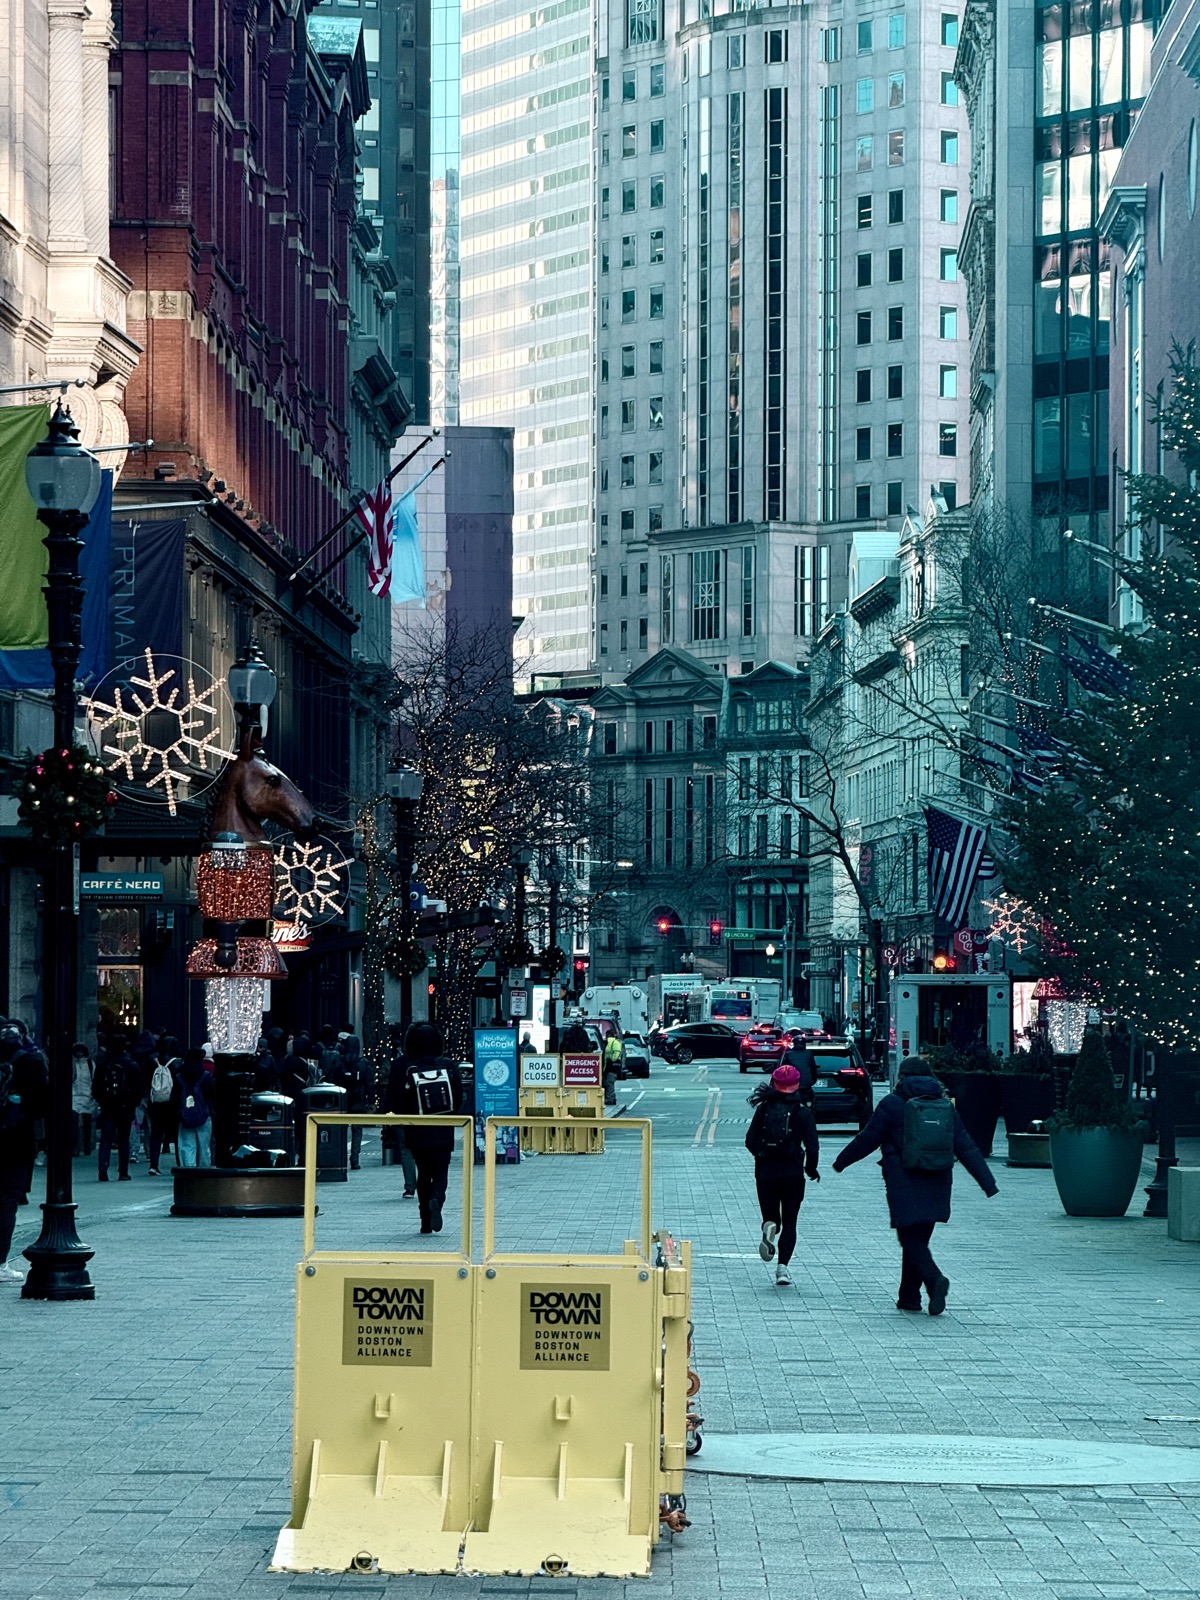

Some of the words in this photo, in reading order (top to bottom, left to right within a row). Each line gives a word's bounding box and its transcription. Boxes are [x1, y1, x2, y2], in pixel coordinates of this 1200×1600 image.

[113, 544, 136, 696] PRIMARK
[125, 880, 161, 890] NERO
[477, 1040, 514, 1049] KINGDOM
[528, 1062, 552, 1071] ROAD
[565, 1059, 600, 1067] EMERGENCY
[524, 1072, 557, 1081] CLOSED
[353, 1287, 424, 1304] DOWN
[530, 1292, 602, 1308] DOWN
[353, 1303, 424, 1320] TOWN
[530, 1308, 602, 1324] TOWN
[358, 1326, 424, 1335] DOWNTOWN
[536, 1330, 601, 1340] DOWNTOWN
[358, 1337, 403, 1346] BOSTON
[535, 1341, 580, 1351] BOSTON
[357, 1348, 412, 1357] ALLIANCE
[535, 1352, 589, 1362] ALLIANCE
